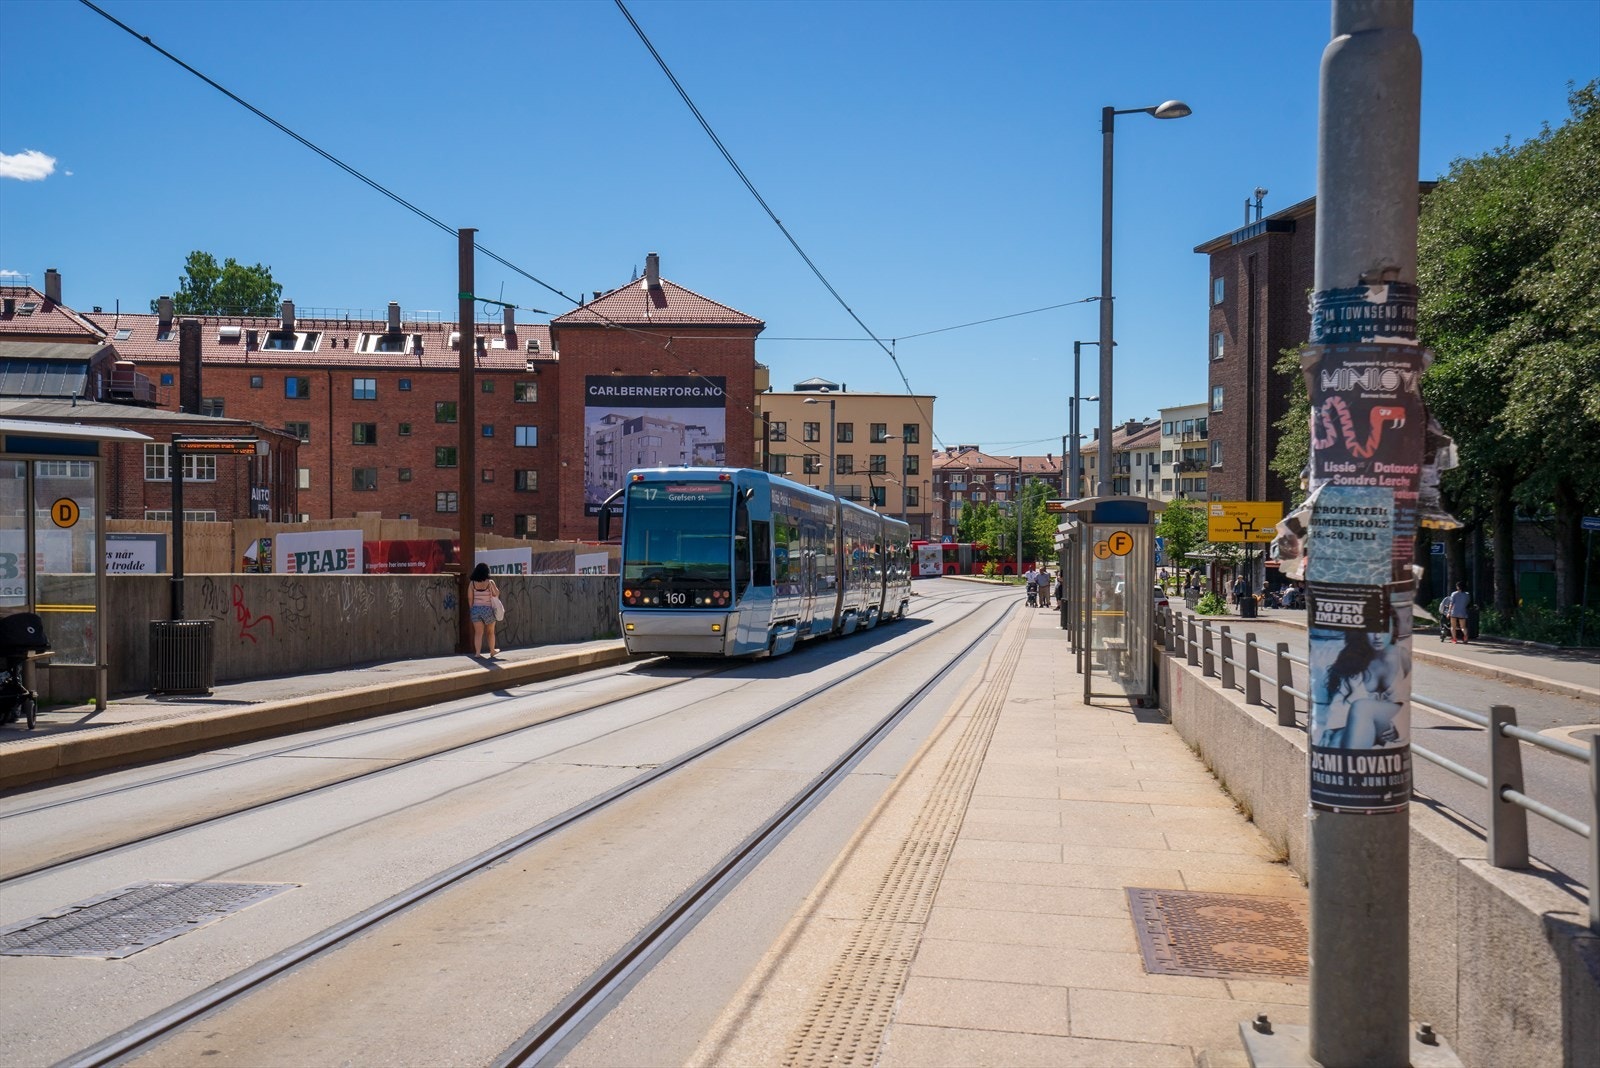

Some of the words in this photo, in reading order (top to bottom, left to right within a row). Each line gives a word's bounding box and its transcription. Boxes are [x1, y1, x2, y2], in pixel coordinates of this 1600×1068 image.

[1340, 305, 1398, 320] TOWNSEND
[589, 385, 723, 397] CARLBERNERTORG.NO
[1324, 461, 1356, 473] Lissie
[1374, 462, 1419, 474] Datarock
[1333, 474, 1377, 486] Sondre
[644, 488, 658, 501] 17
[668, 494, 696, 502] Grefsen
[60, 504, 72, 521] D
[1350, 532, 1377, 542] JULI
[1099, 544, 1107, 555] F
[1116, 536, 1126, 551] F
[115, 549, 134, 559] når
[111, 560, 146, 571] trodde
[294, 548, 348, 573] PEAB
[665, 592, 686, 604] 160
[1316, 602, 1364, 614] TØYEN
[1315, 612, 1365, 625] IMPRO
[1312, 751, 1343, 773] DEMI
[1347, 754, 1402, 774] LOVATO
[1313, 771, 1344, 786] FREDAG
[1348, 776, 1357, 787] 1.
[1361, 776, 1387, 787] JUNI
